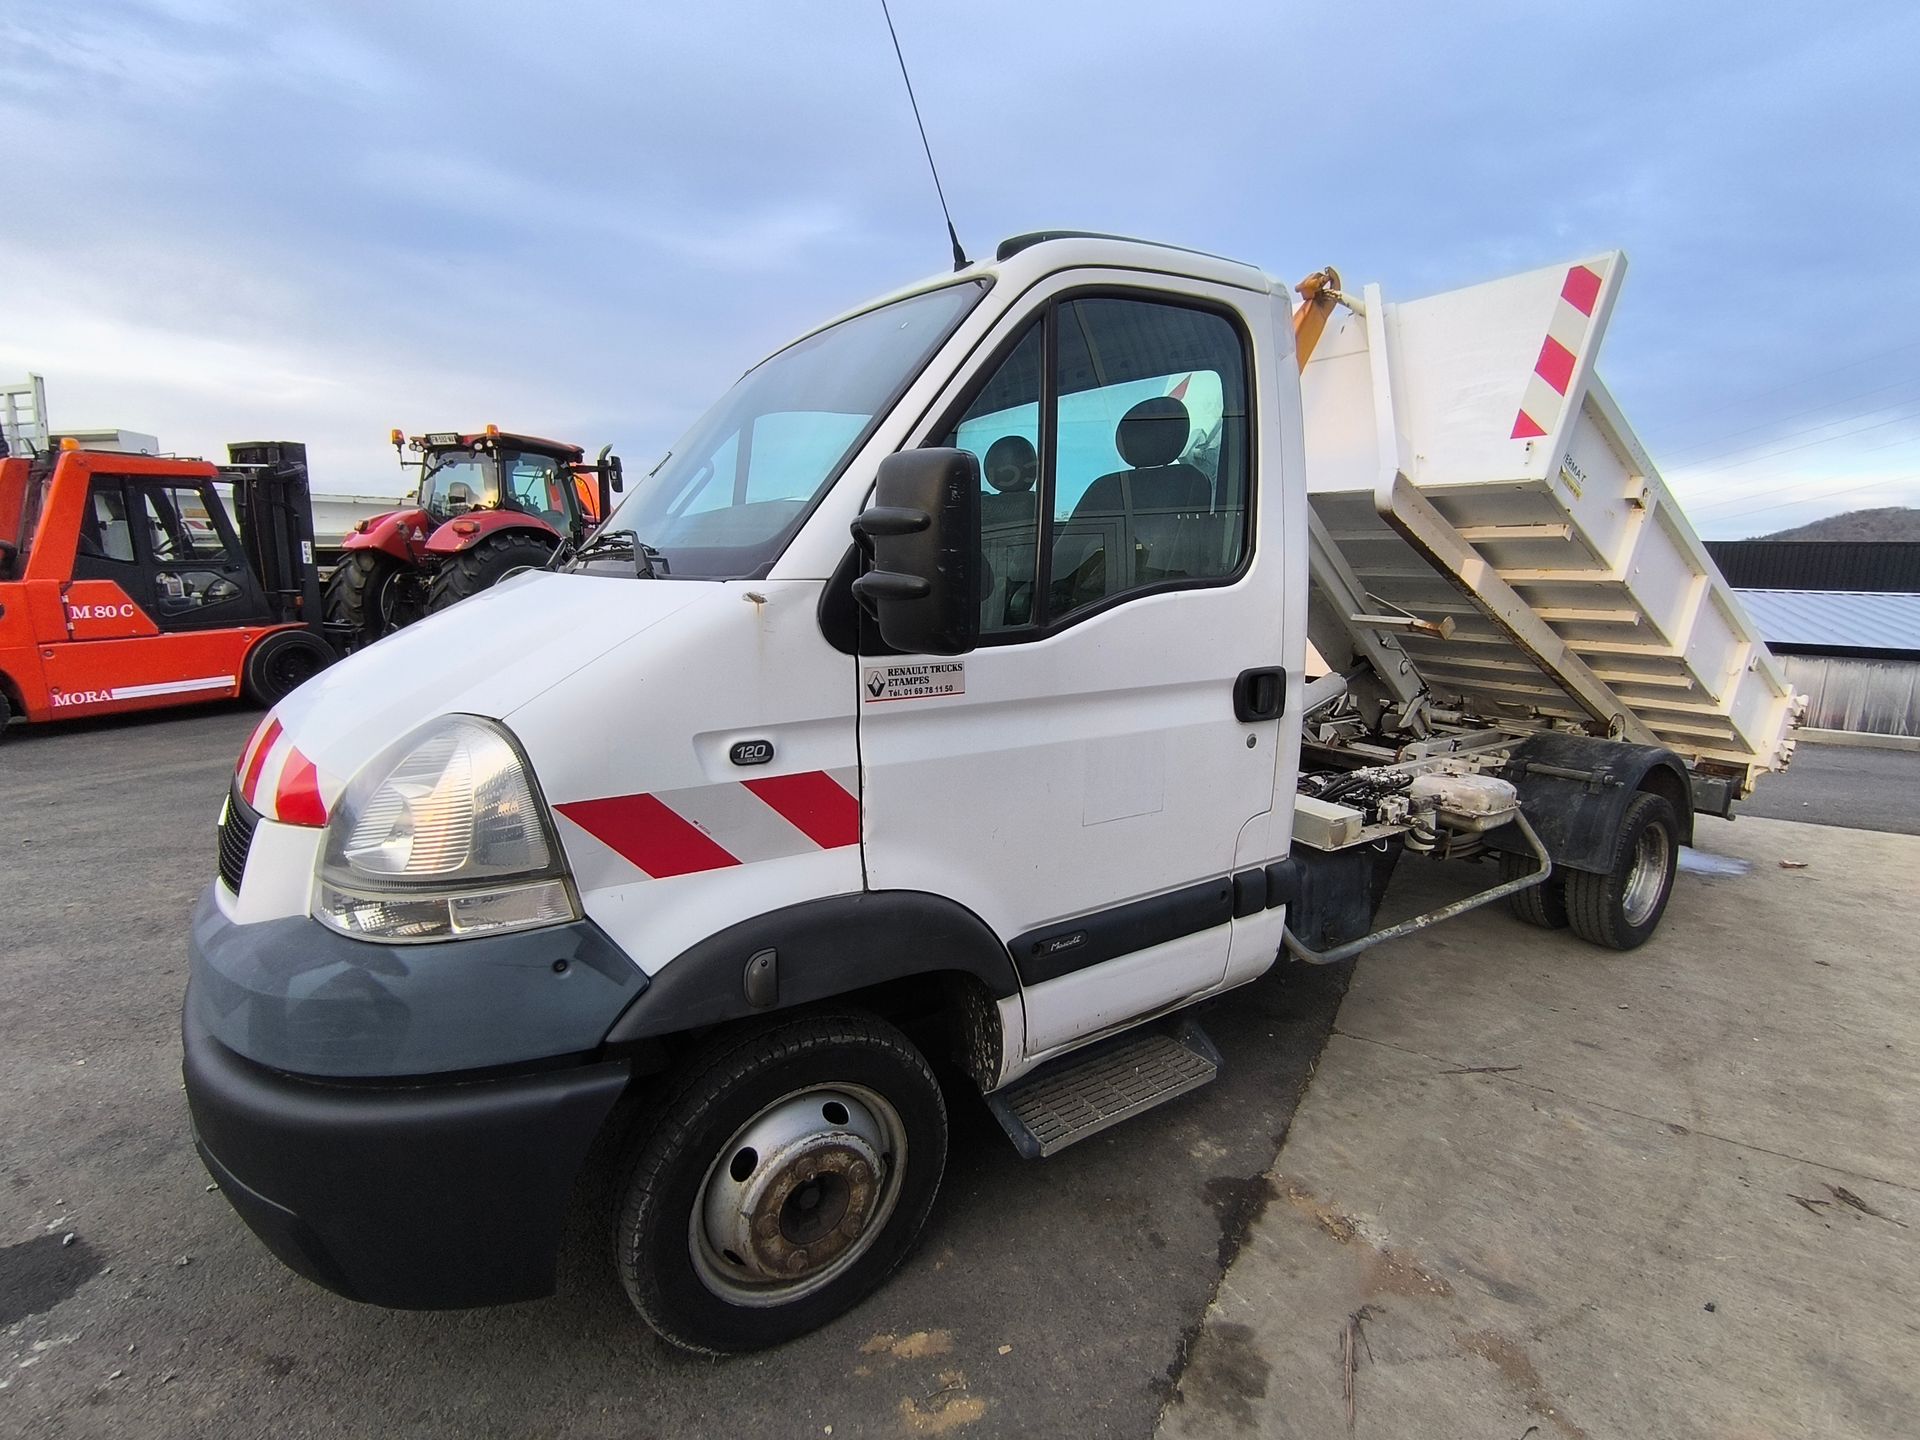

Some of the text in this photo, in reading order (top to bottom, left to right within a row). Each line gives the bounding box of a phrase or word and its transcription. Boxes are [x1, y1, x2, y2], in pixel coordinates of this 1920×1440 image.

[71, 604, 134, 619] M 80 C
[888, 663, 963, 677] RENAULT TRUCKS
[888, 676, 930, 687] ETAMPES
[935, 685, 943, 693] 11
[944, 684, 953, 692] 50
[53, 689, 112, 707] MORA
[737, 745, 766, 758] 120
